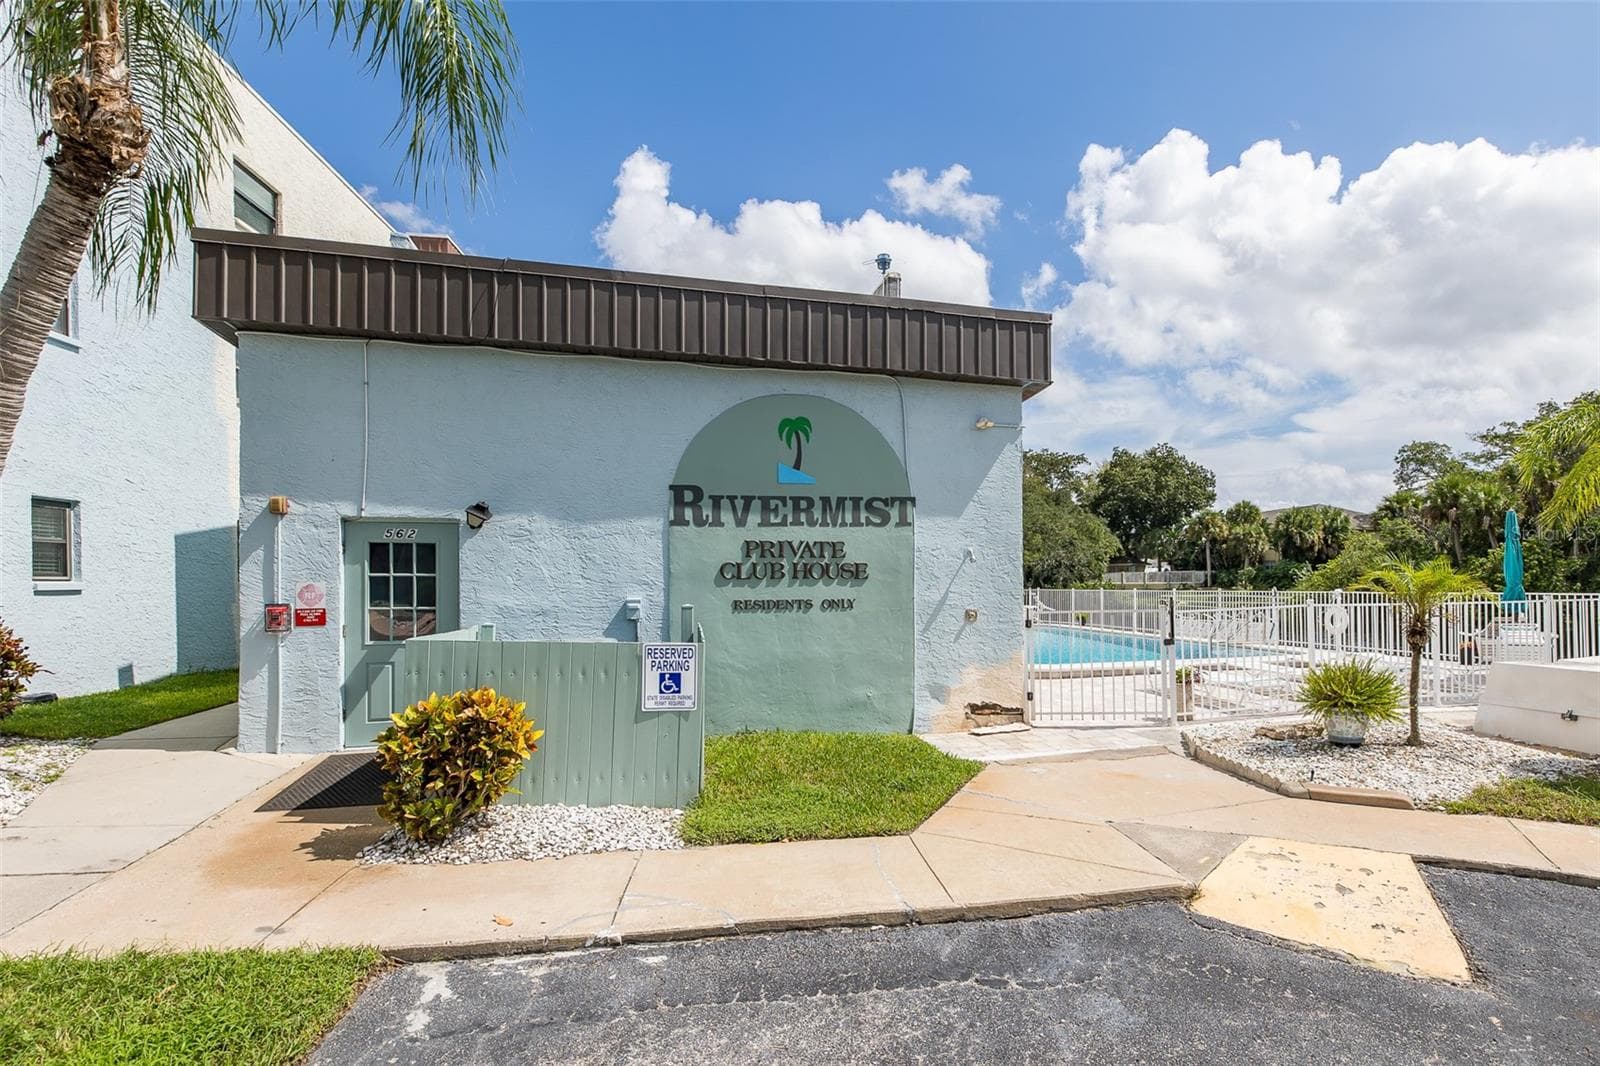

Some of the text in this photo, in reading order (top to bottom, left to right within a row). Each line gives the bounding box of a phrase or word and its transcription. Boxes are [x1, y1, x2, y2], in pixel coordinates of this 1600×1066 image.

[669, 485, 916, 528] RIVERMIST
[384, 528, 417, 539] 562
[744, 540, 847, 559] PRIVATE
[719, 562, 870, 580] CLUB HOUSE
[733, 598, 856, 611] RESIDENTS ONLY
[647, 648, 694, 659] RESERVED
[650, 660, 690, 671] PARKING
